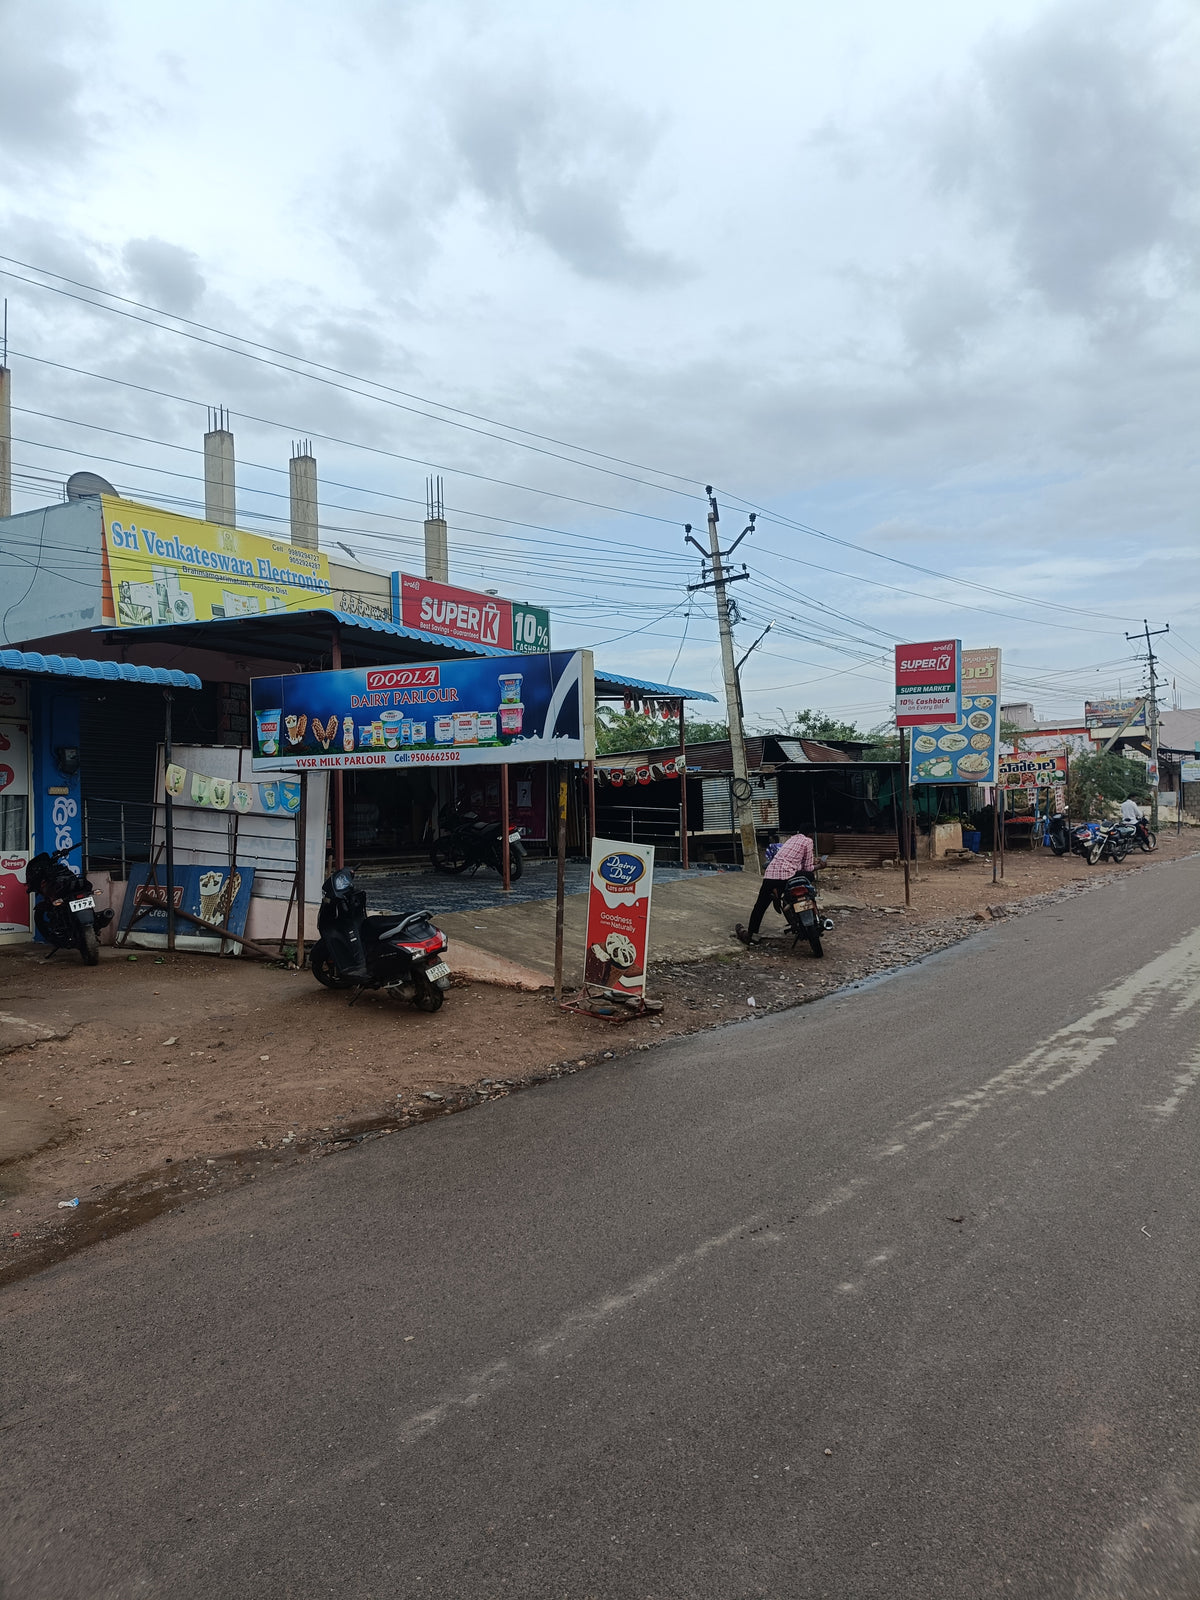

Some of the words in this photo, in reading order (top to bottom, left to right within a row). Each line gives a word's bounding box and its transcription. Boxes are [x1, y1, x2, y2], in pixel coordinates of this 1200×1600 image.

[111, 521, 140, 550] Sri
[141, 529, 254, 578] Venkateswara
[256, 558, 331, 595] Electronics
[419, 596, 480, 631] SUPER
[481, 606, 499, 644] K
[514, 611, 549, 647] 10%
[420, 621, 430, 630] Best
[431, 624, 450, 635] Savings
[453, 629, 480, 640] Guaranteed
[900, 658, 936, 670] SUPER
[938, 655, 950, 670] K
[369, 669, 437, 688] DODLA
[900, 686, 924, 694] SUPER
[924, 684, 951, 693] MARKET
[350, 691, 390, 709] DAIRY
[394, 688, 459, 706] PARLOUR
[900, 698, 914, 706] 10%
[915, 697, 950, 705] Cashback
[295, 759, 317, 768] YVSR
[319, 757, 342, 767] MILK
[344, 755, 387, 766] PARLOUR
[3, 859, 25, 869] Jersey
[606, 855, 637, 875] Dairy
[609, 867, 632, 885] Day
[600, 911, 633, 925] Goodness
[611, 922, 636, 934] Naturally
